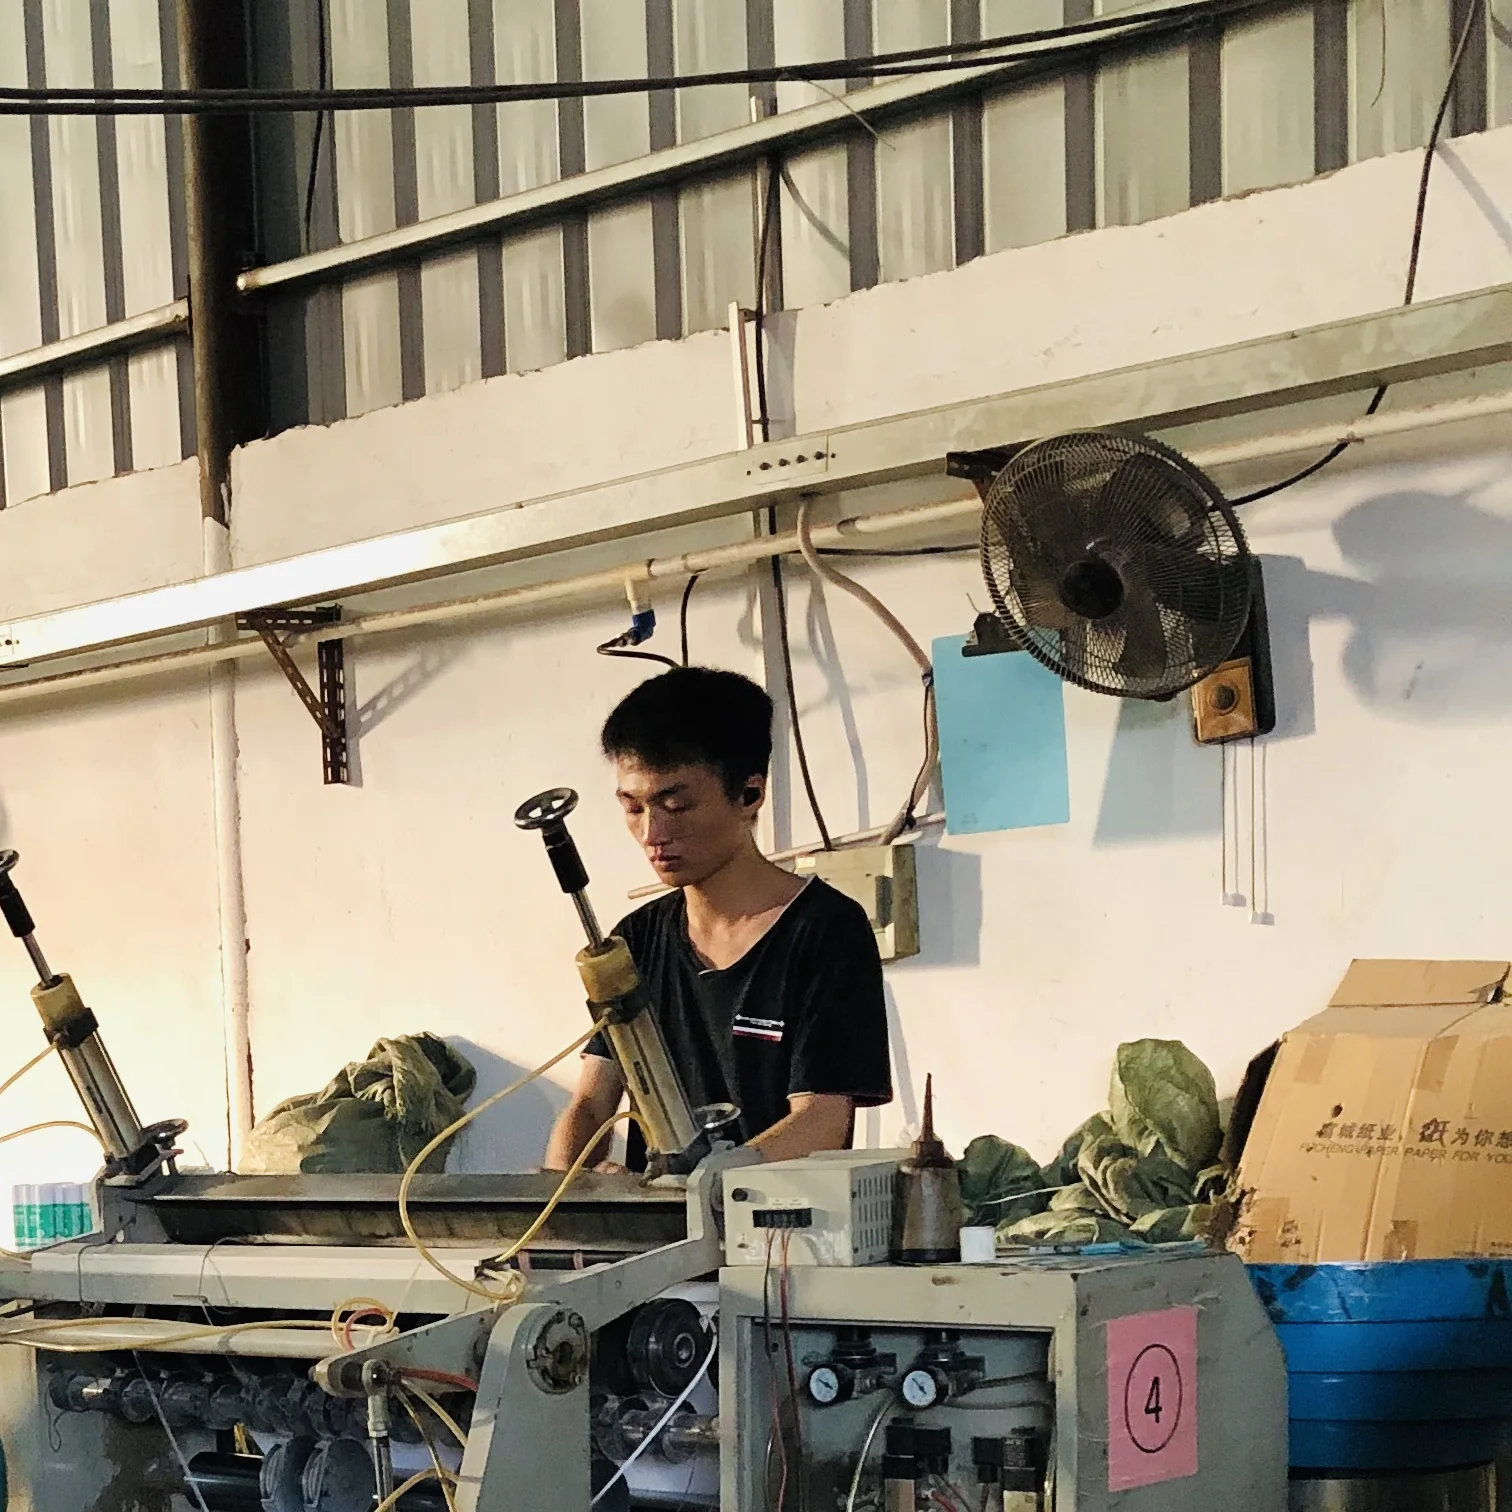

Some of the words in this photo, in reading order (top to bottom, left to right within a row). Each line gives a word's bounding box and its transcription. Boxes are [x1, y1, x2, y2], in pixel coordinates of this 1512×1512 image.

[1405, 1147, 1446, 1161] PAPER
[1452, 1150, 1480, 1162] FOR
[1144, 1376, 1162, 1423] 4
